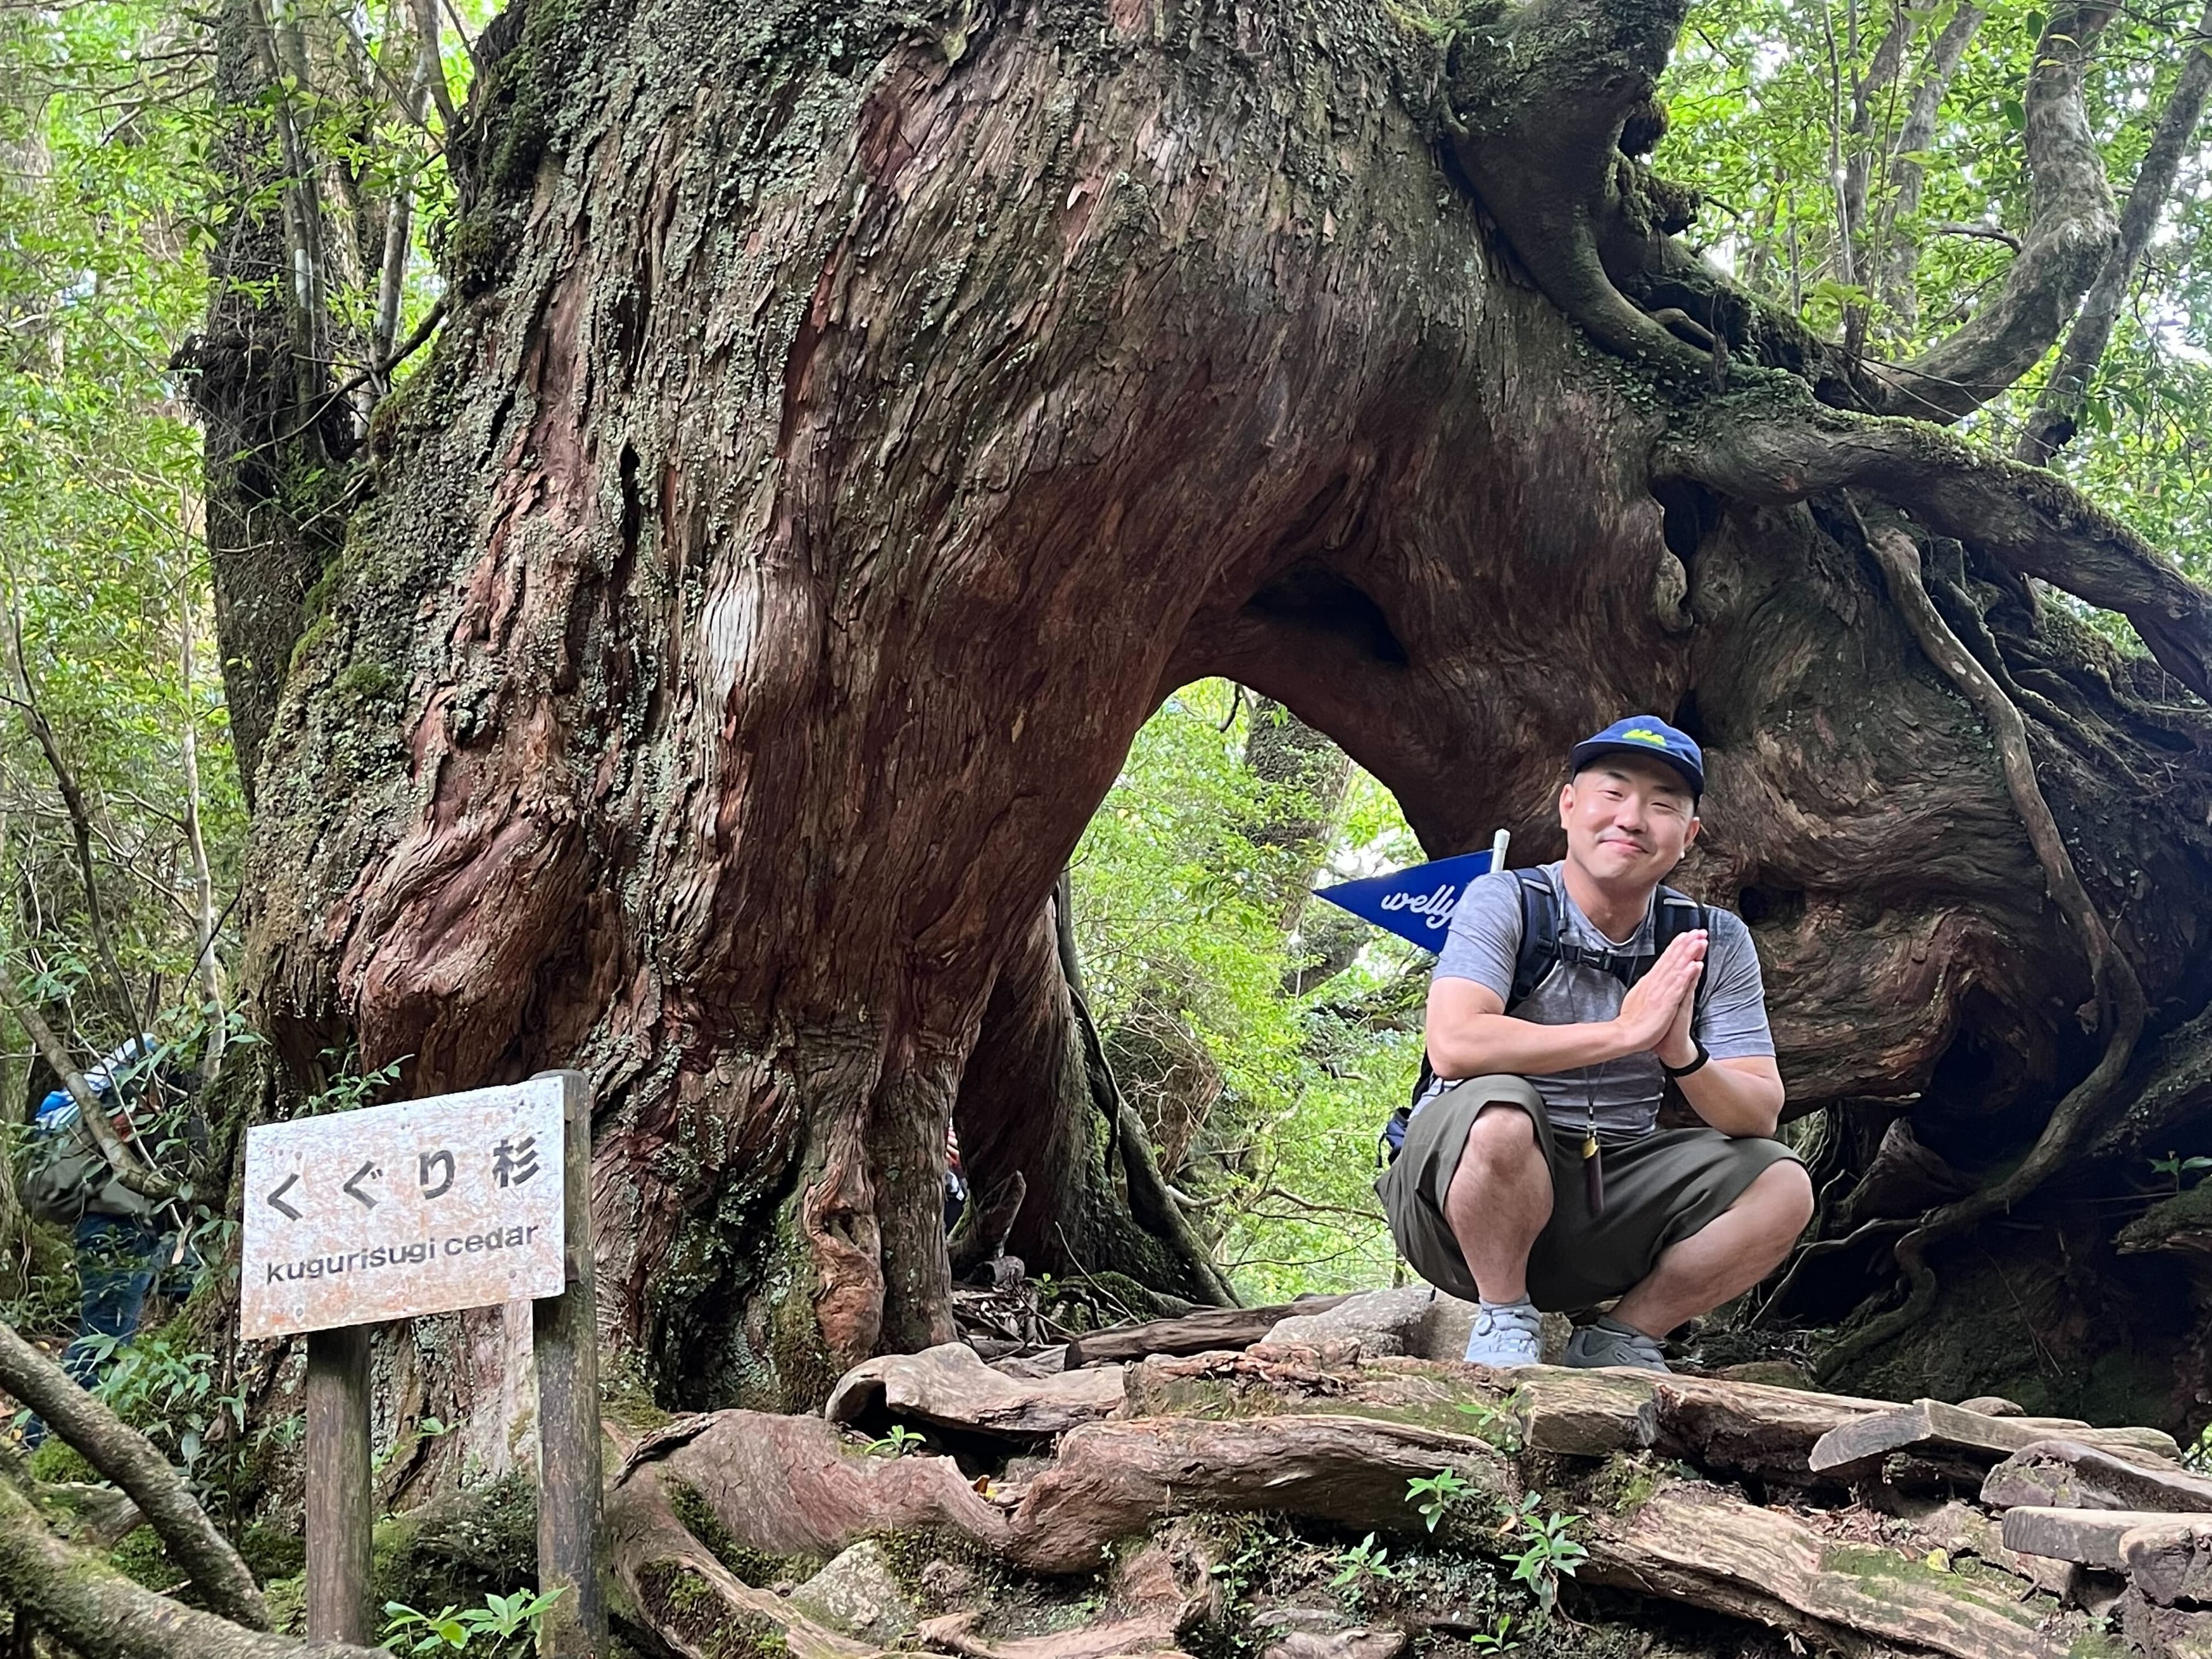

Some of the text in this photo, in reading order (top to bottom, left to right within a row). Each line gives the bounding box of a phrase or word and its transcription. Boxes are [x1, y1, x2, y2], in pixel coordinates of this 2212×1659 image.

[266, 1137, 541, 1221] くぐり杉
[266, 1224, 540, 1285] kugurisugi cedar
